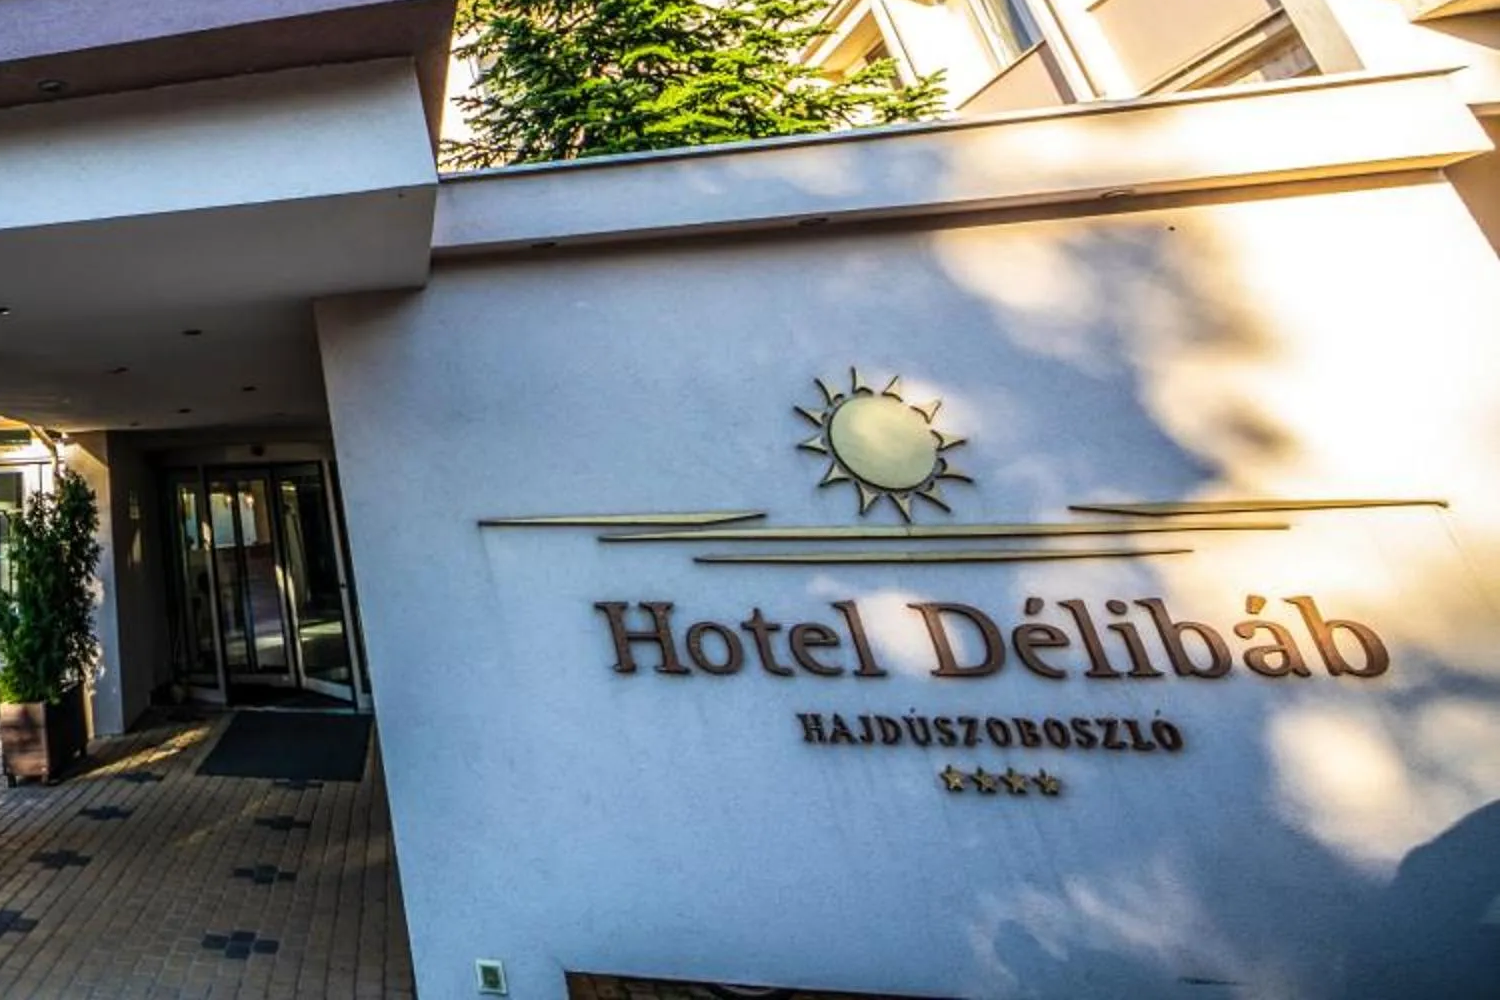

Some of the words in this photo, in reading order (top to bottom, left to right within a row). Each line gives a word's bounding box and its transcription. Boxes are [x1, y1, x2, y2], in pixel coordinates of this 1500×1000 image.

[594, 599, 887, 678] Hotel
[908, 595, 1391, 680] Délibáb
[796, 706, 1185, 753] HAJDÚSZOBOSZLÓ
